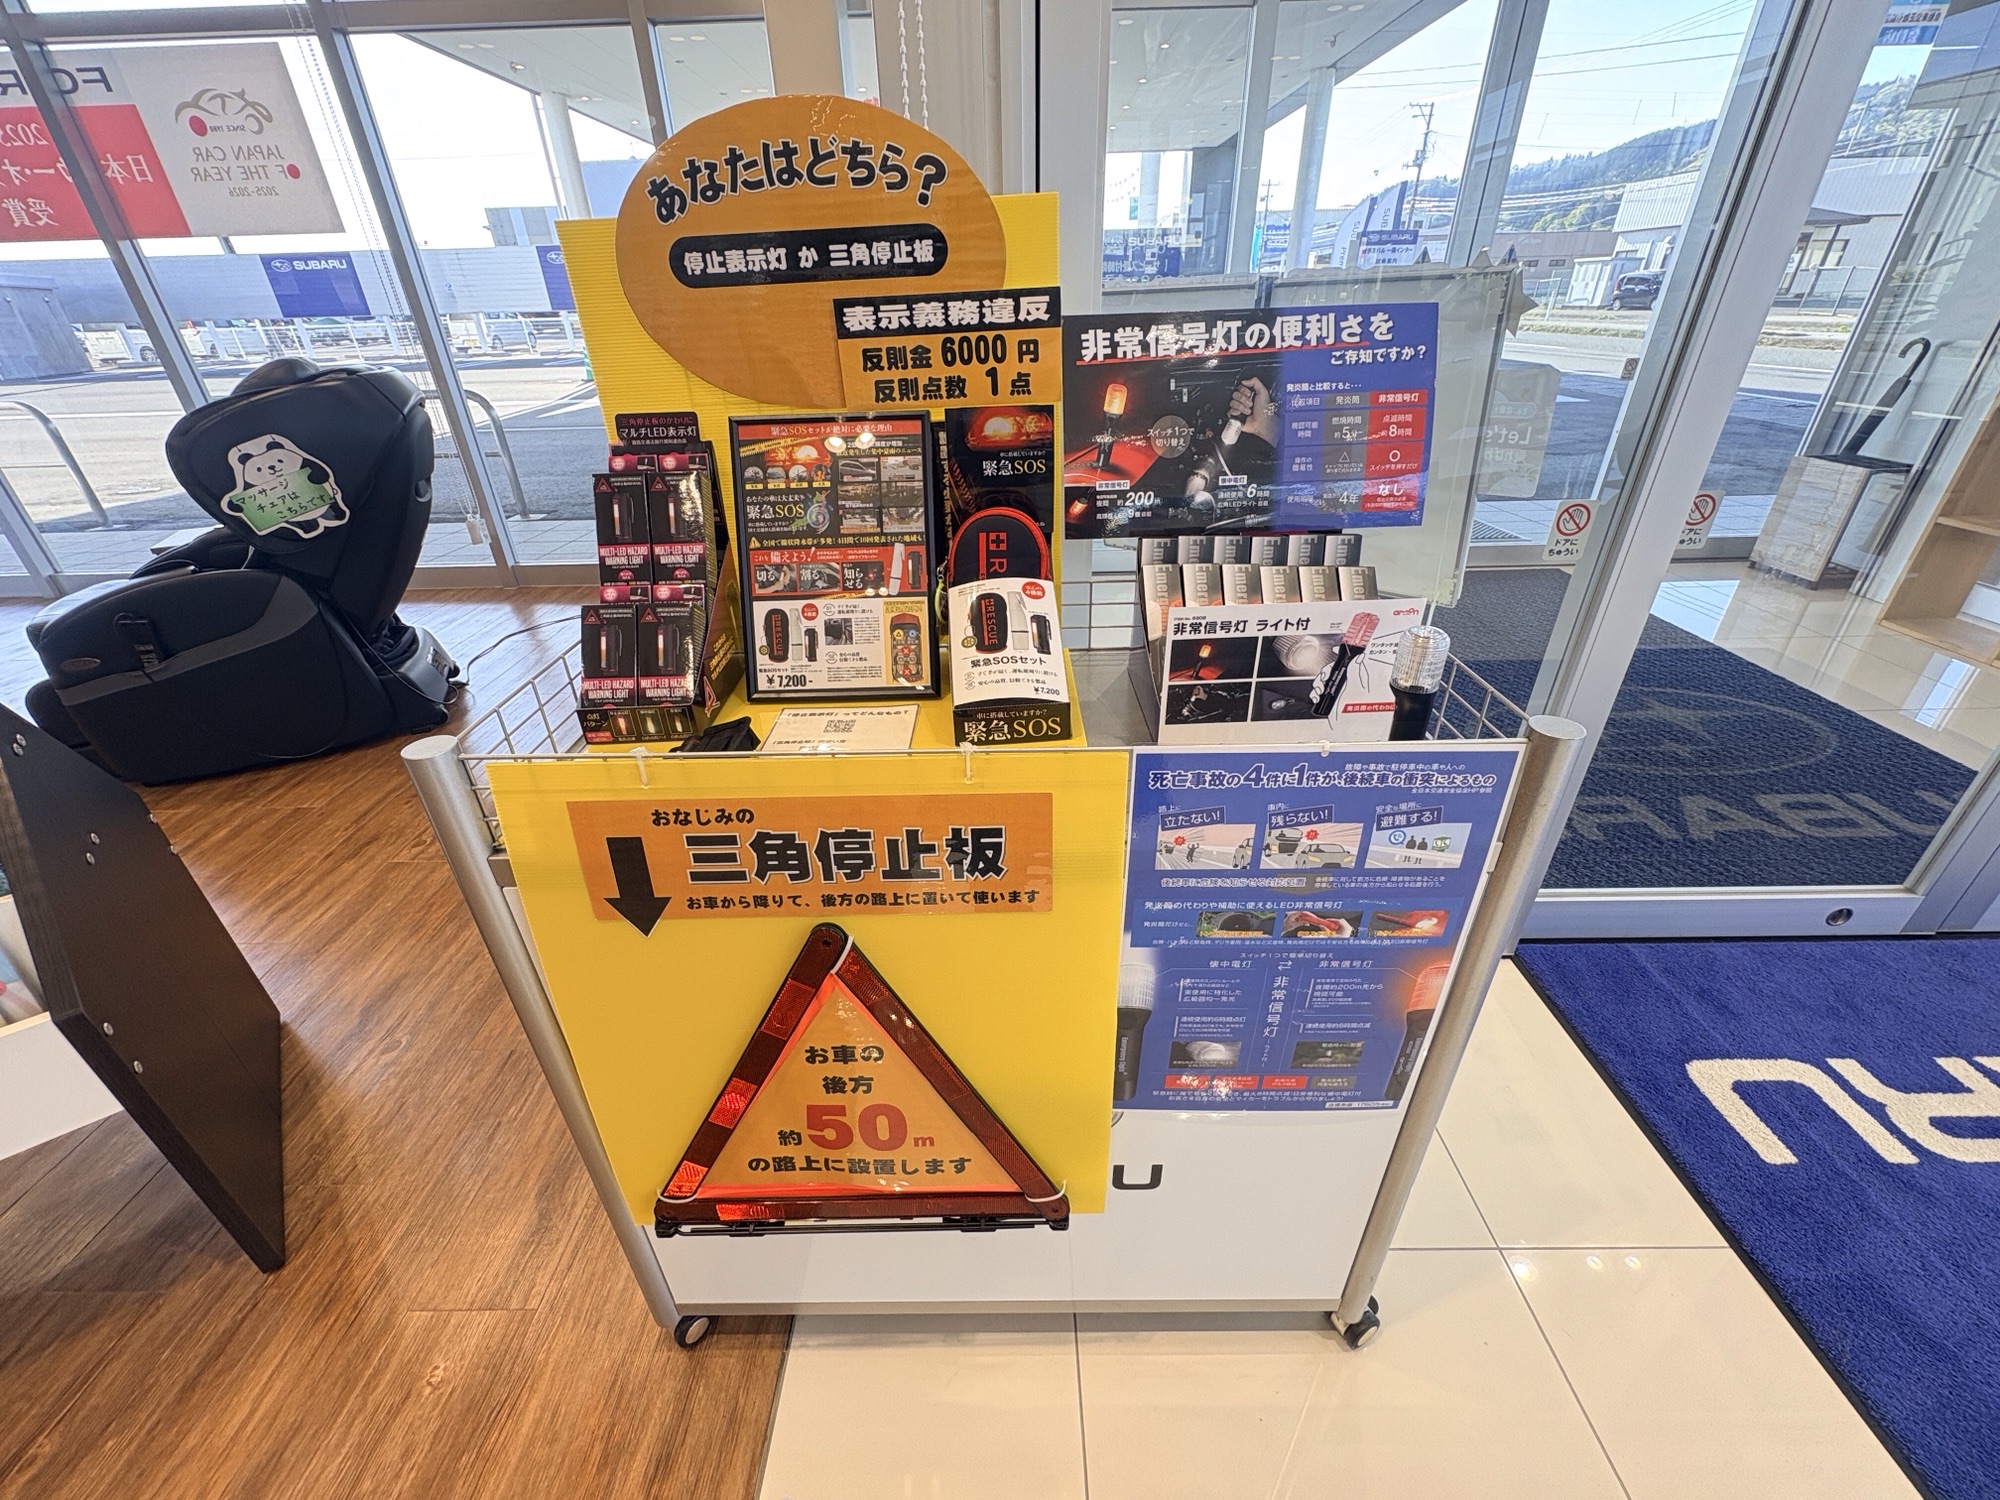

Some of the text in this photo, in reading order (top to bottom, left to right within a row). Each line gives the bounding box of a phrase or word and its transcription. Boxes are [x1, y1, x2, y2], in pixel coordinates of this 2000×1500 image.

[645, 135, 948, 225] あなたはどちら?
[293, 258, 347, 271] SUBARU
[683, 239, 935, 275] 停止表示灯 か 三角停止板
[842, 294, 1051, 332] 表示義務違反
[1080, 311, 1395, 363] 非常信号灯の便利さを
[861, 334, 1040, 374] 反則金 6000 円
[1330, 345, 1427, 366] ご存知ですか?
[873, 366, 1033, 403] 反則点数 1 点
[1335, 395, 1361, 405] 発炎筒
[1378, 392, 1420, 403] 非常信号灯
[619, 426, 698, 439] マルチLED表示灯
[1147, 427, 1195, 437] スイッチ1つで
[1155, 437, 1186, 447] 切り替え
[982, 459, 1047, 477] 緊急SOS
[235, 478, 289, 506] マッサージ
[1378, 483, 1404, 496] なし
[256, 490, 301, 514] チェアは
[746, 503, 806, 520] 緊急SOS
[1554, 538, 1579, 547] ドアに
[756, 570, 776, 582] 切る
[985, 605, 999, 645] RESCUE
[1173, 619, 1249, 637] 非常信号灯
[1256, 617, 1311, 632] ライト付
[970, 654, 1047, 669] 緊急SOSセット
[963, 716, 1062, 743] 緊急SOS
[1148, 762, 1498, 789] 死亡事故の4件に1件が、後続車の衝突によるもの
[650, 807, 756, 827] おなじみの
[1163, 810, 1221, 828] 立たない!
[1271, 809, 1329, 826] 残らない!
[1380, 810, 1438, 829] 避難する!
[682, 824, 1009, 887] 三角停止板
[1209, 960, 1374, 969] 懐中電灯 非常信号灯
[1262, 975, 1291, 1038] 非常信号灯
[804, 1044, 885, 1065] お車の
[821, 1075, 875, 1095] 後方
[747, 1156, 972, 1176] の路上に設置します
